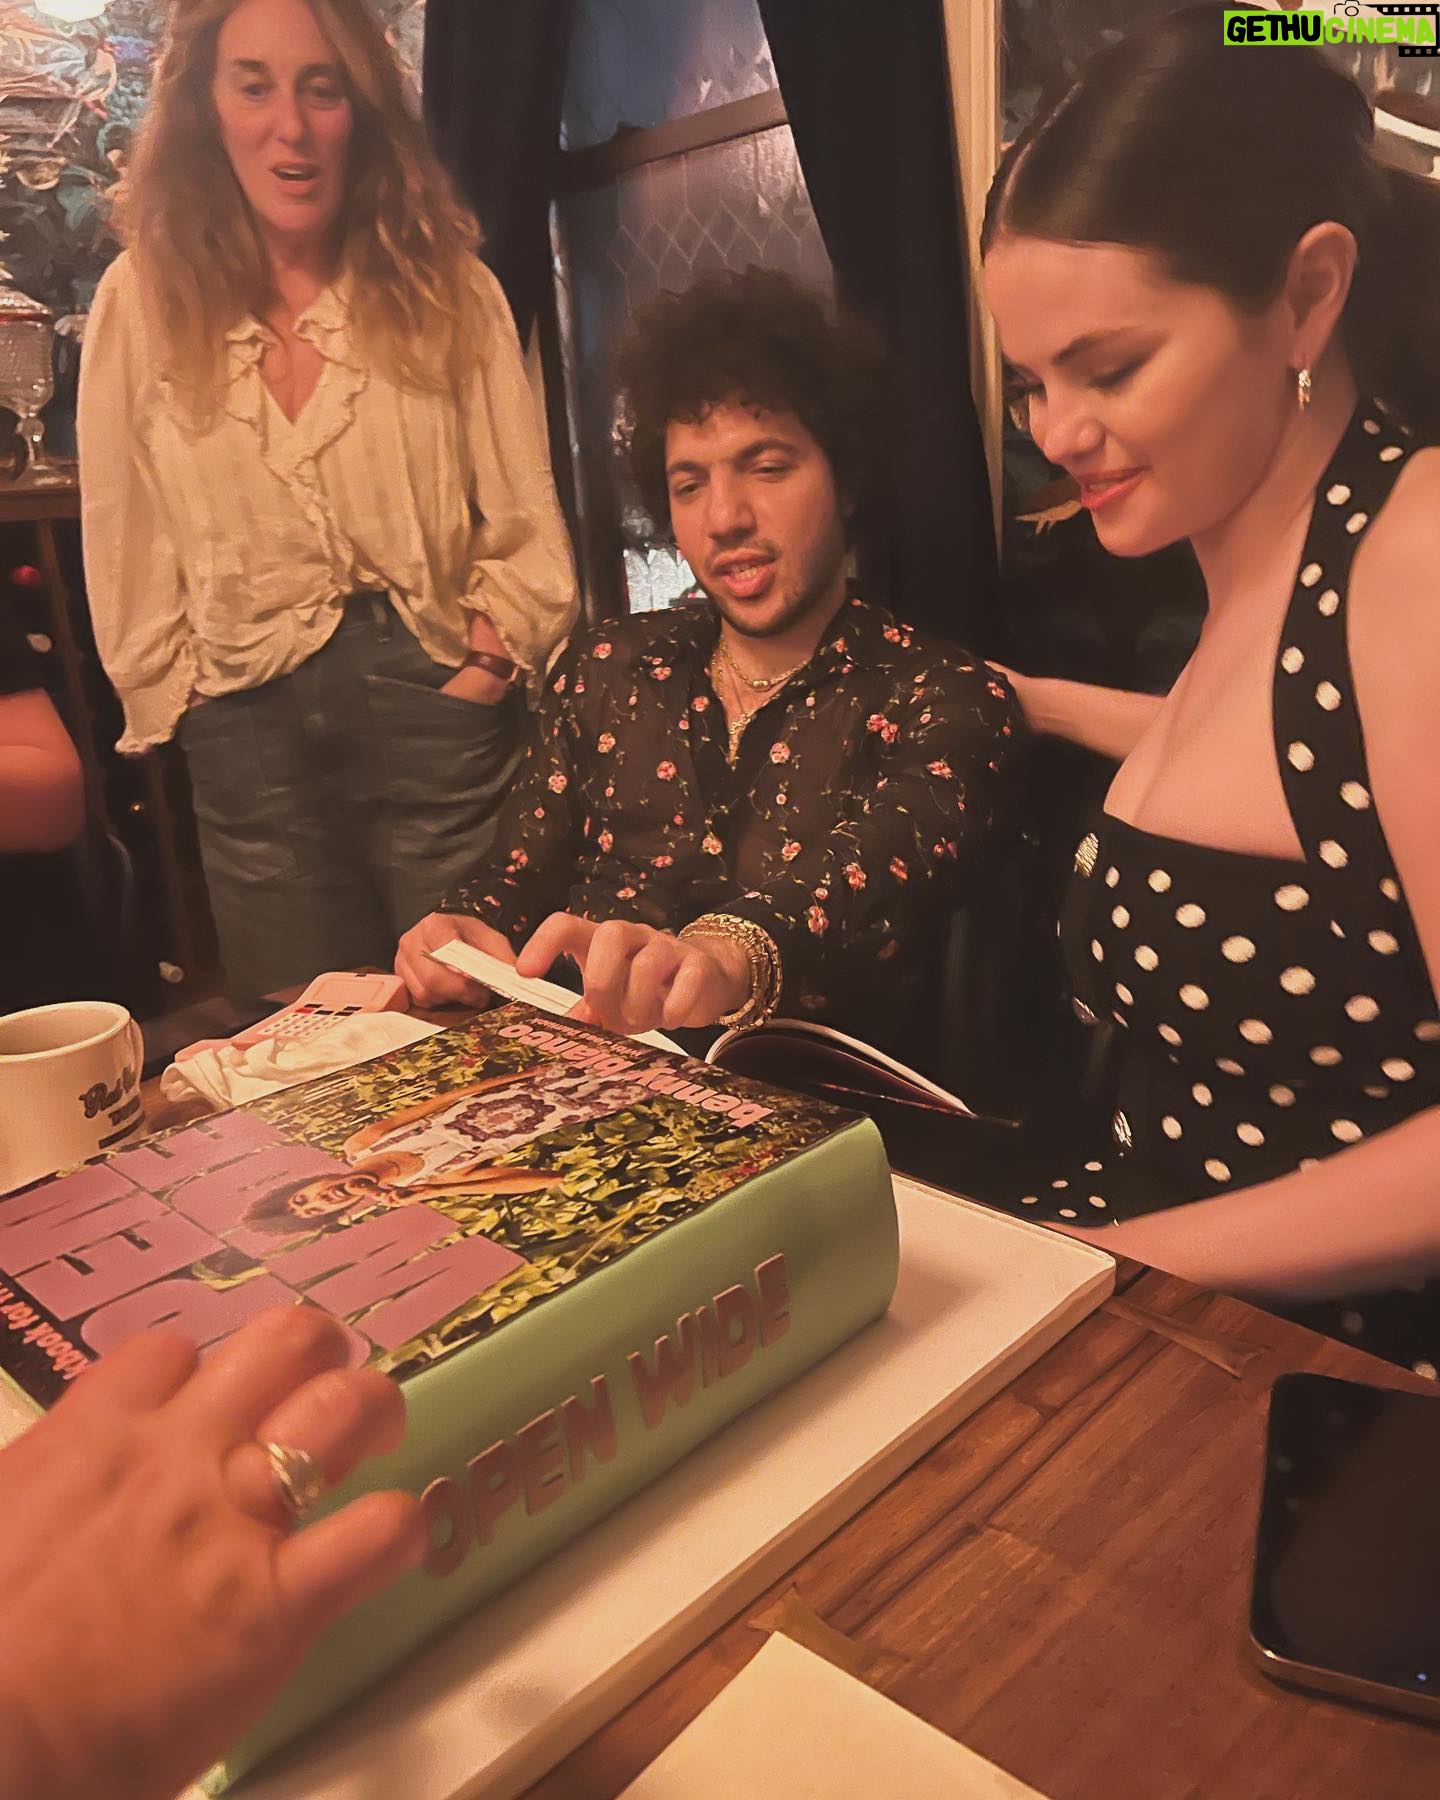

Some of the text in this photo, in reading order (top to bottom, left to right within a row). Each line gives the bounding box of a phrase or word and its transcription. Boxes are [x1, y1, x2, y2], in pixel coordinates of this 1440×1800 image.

[498, 1024, 775, 1129] benny blanco
[0, 1301, 40, 1331] for
[419, 1252, 793, 1578] OPEN WIDE
